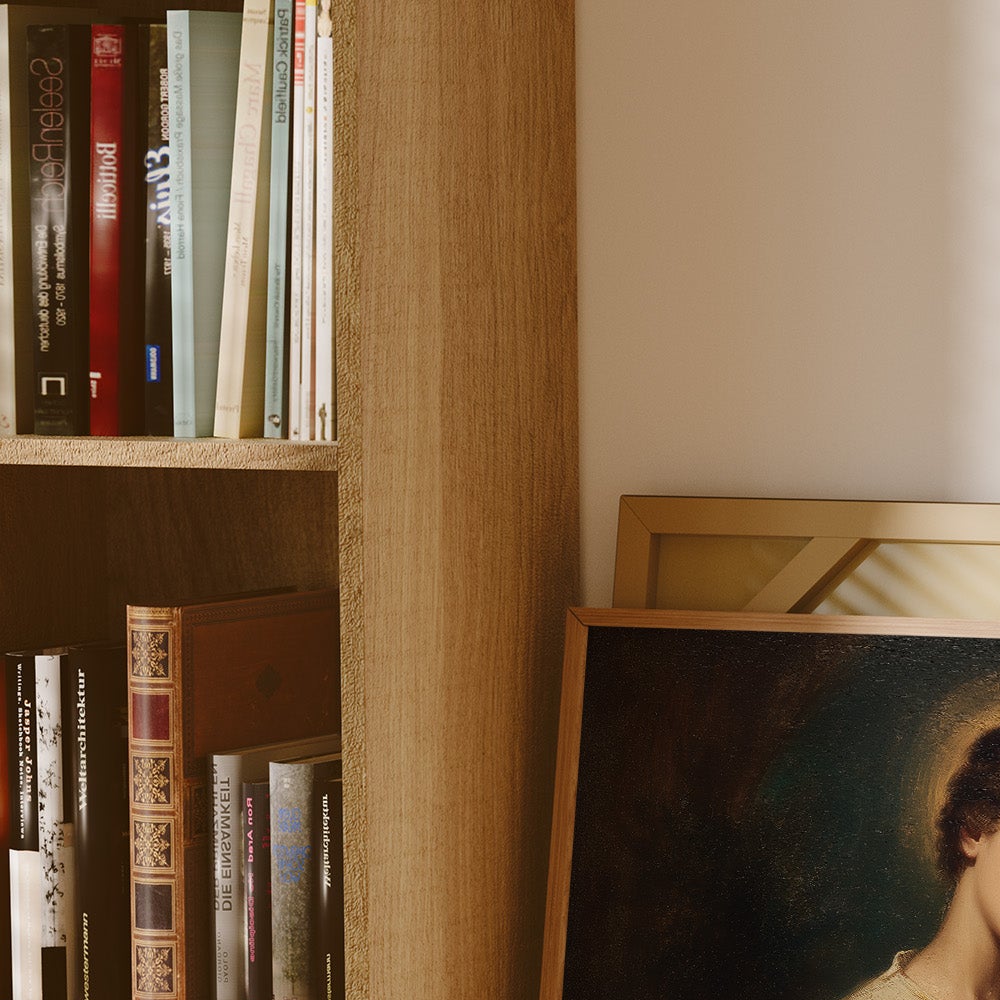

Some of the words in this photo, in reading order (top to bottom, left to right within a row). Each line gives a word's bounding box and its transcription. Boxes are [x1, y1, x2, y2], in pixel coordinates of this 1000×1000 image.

[23, 698, 31, 752] Jasper
[76, 667, 87, 812] Weltarchitektur
[24, 755, 32, 802] Johns
